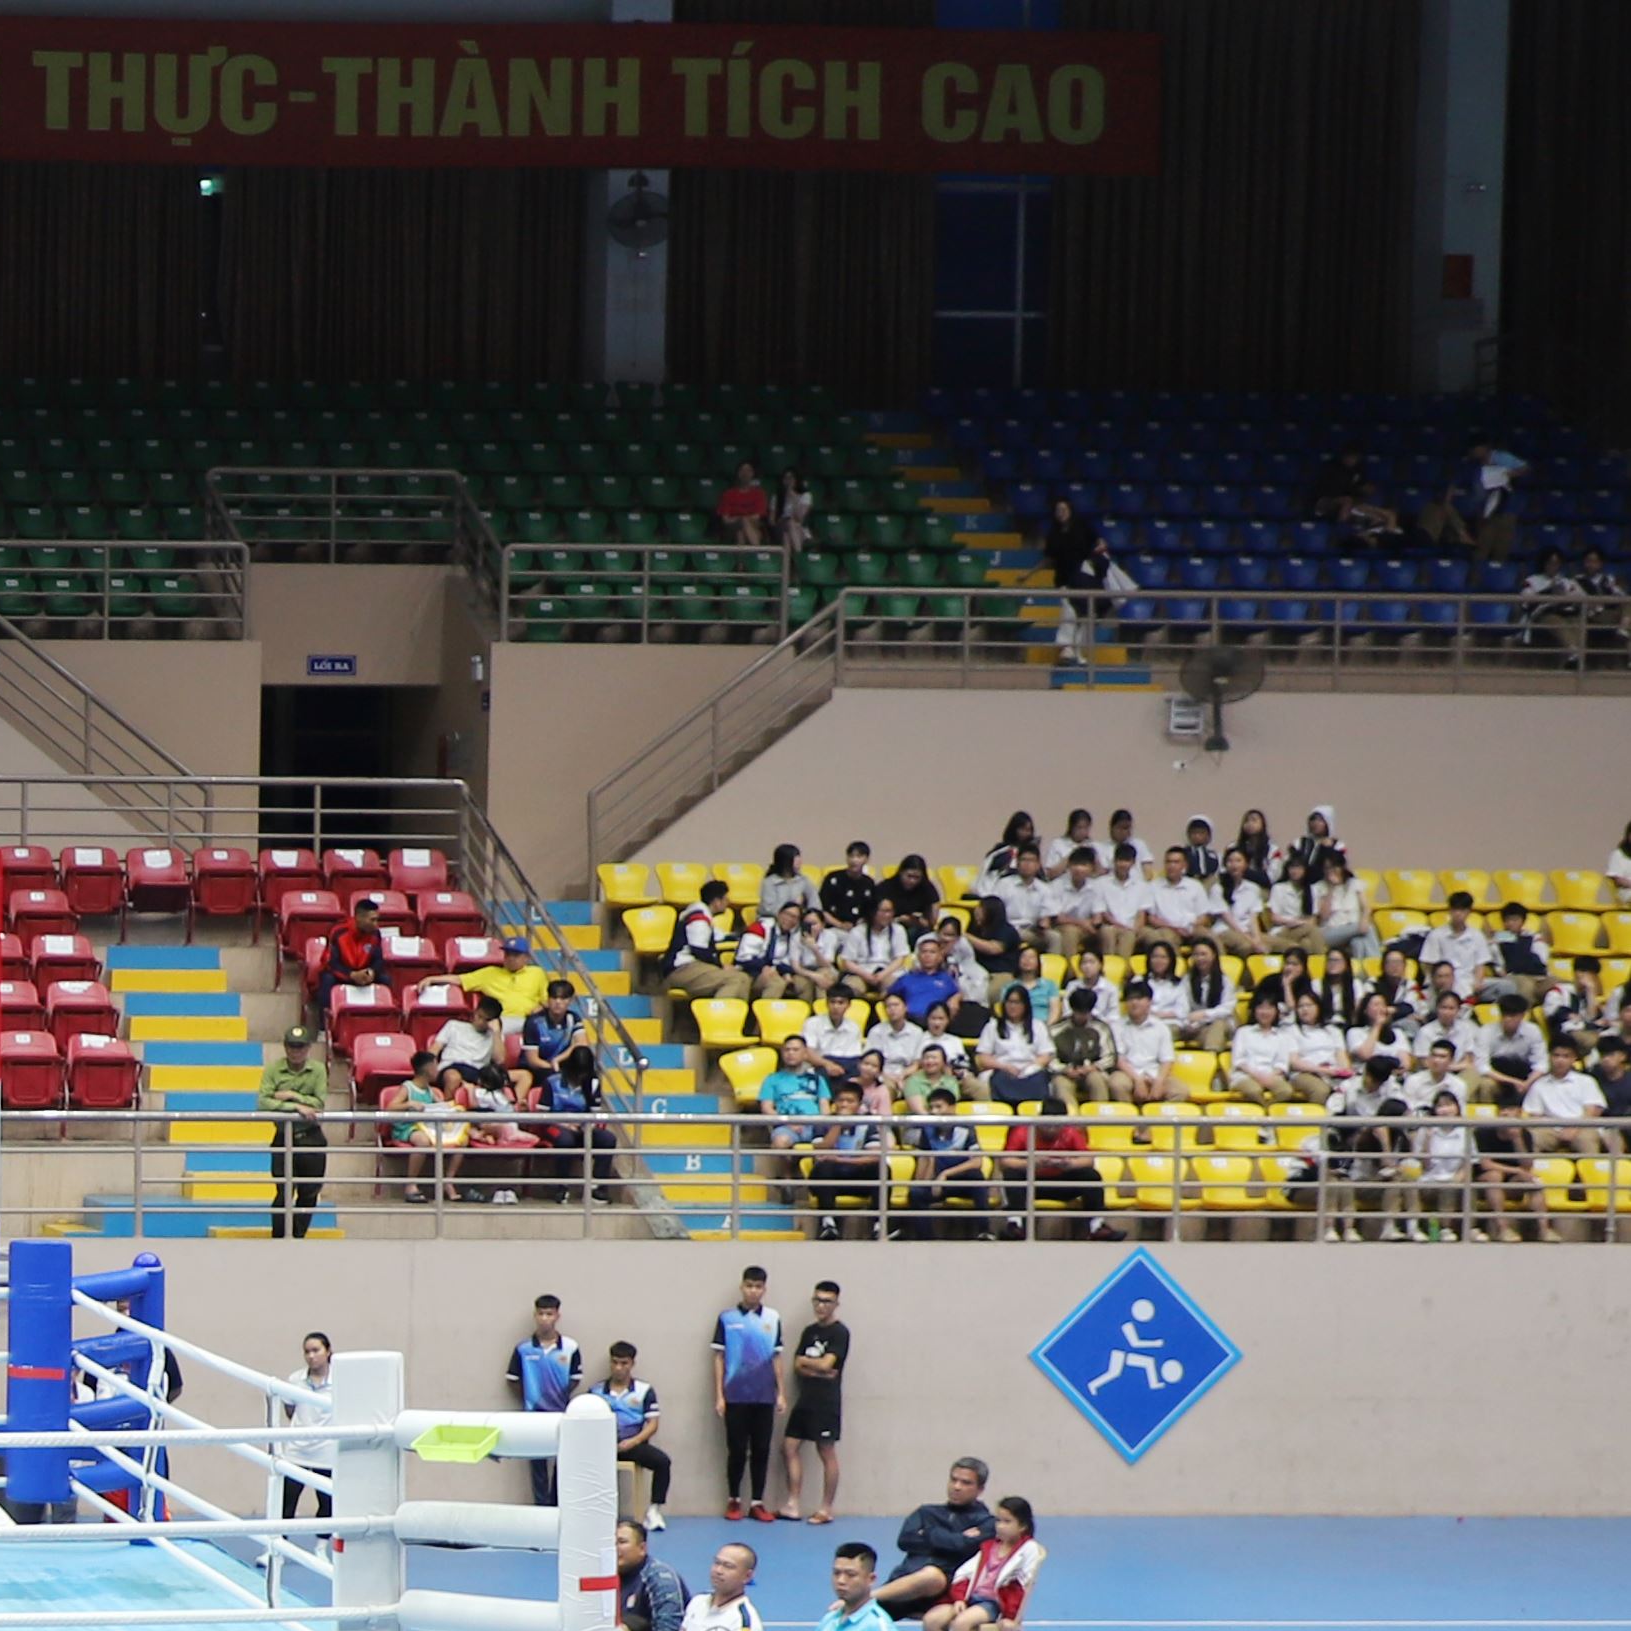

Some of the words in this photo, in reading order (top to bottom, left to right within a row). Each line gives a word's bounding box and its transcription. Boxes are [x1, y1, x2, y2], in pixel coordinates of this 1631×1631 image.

[671, 40, 881, 141] TÍCH
[921, 62, 1105, 146] CAO
[651, 1098, 669, 1114] C
[684, 1154, 702, 1171] B
